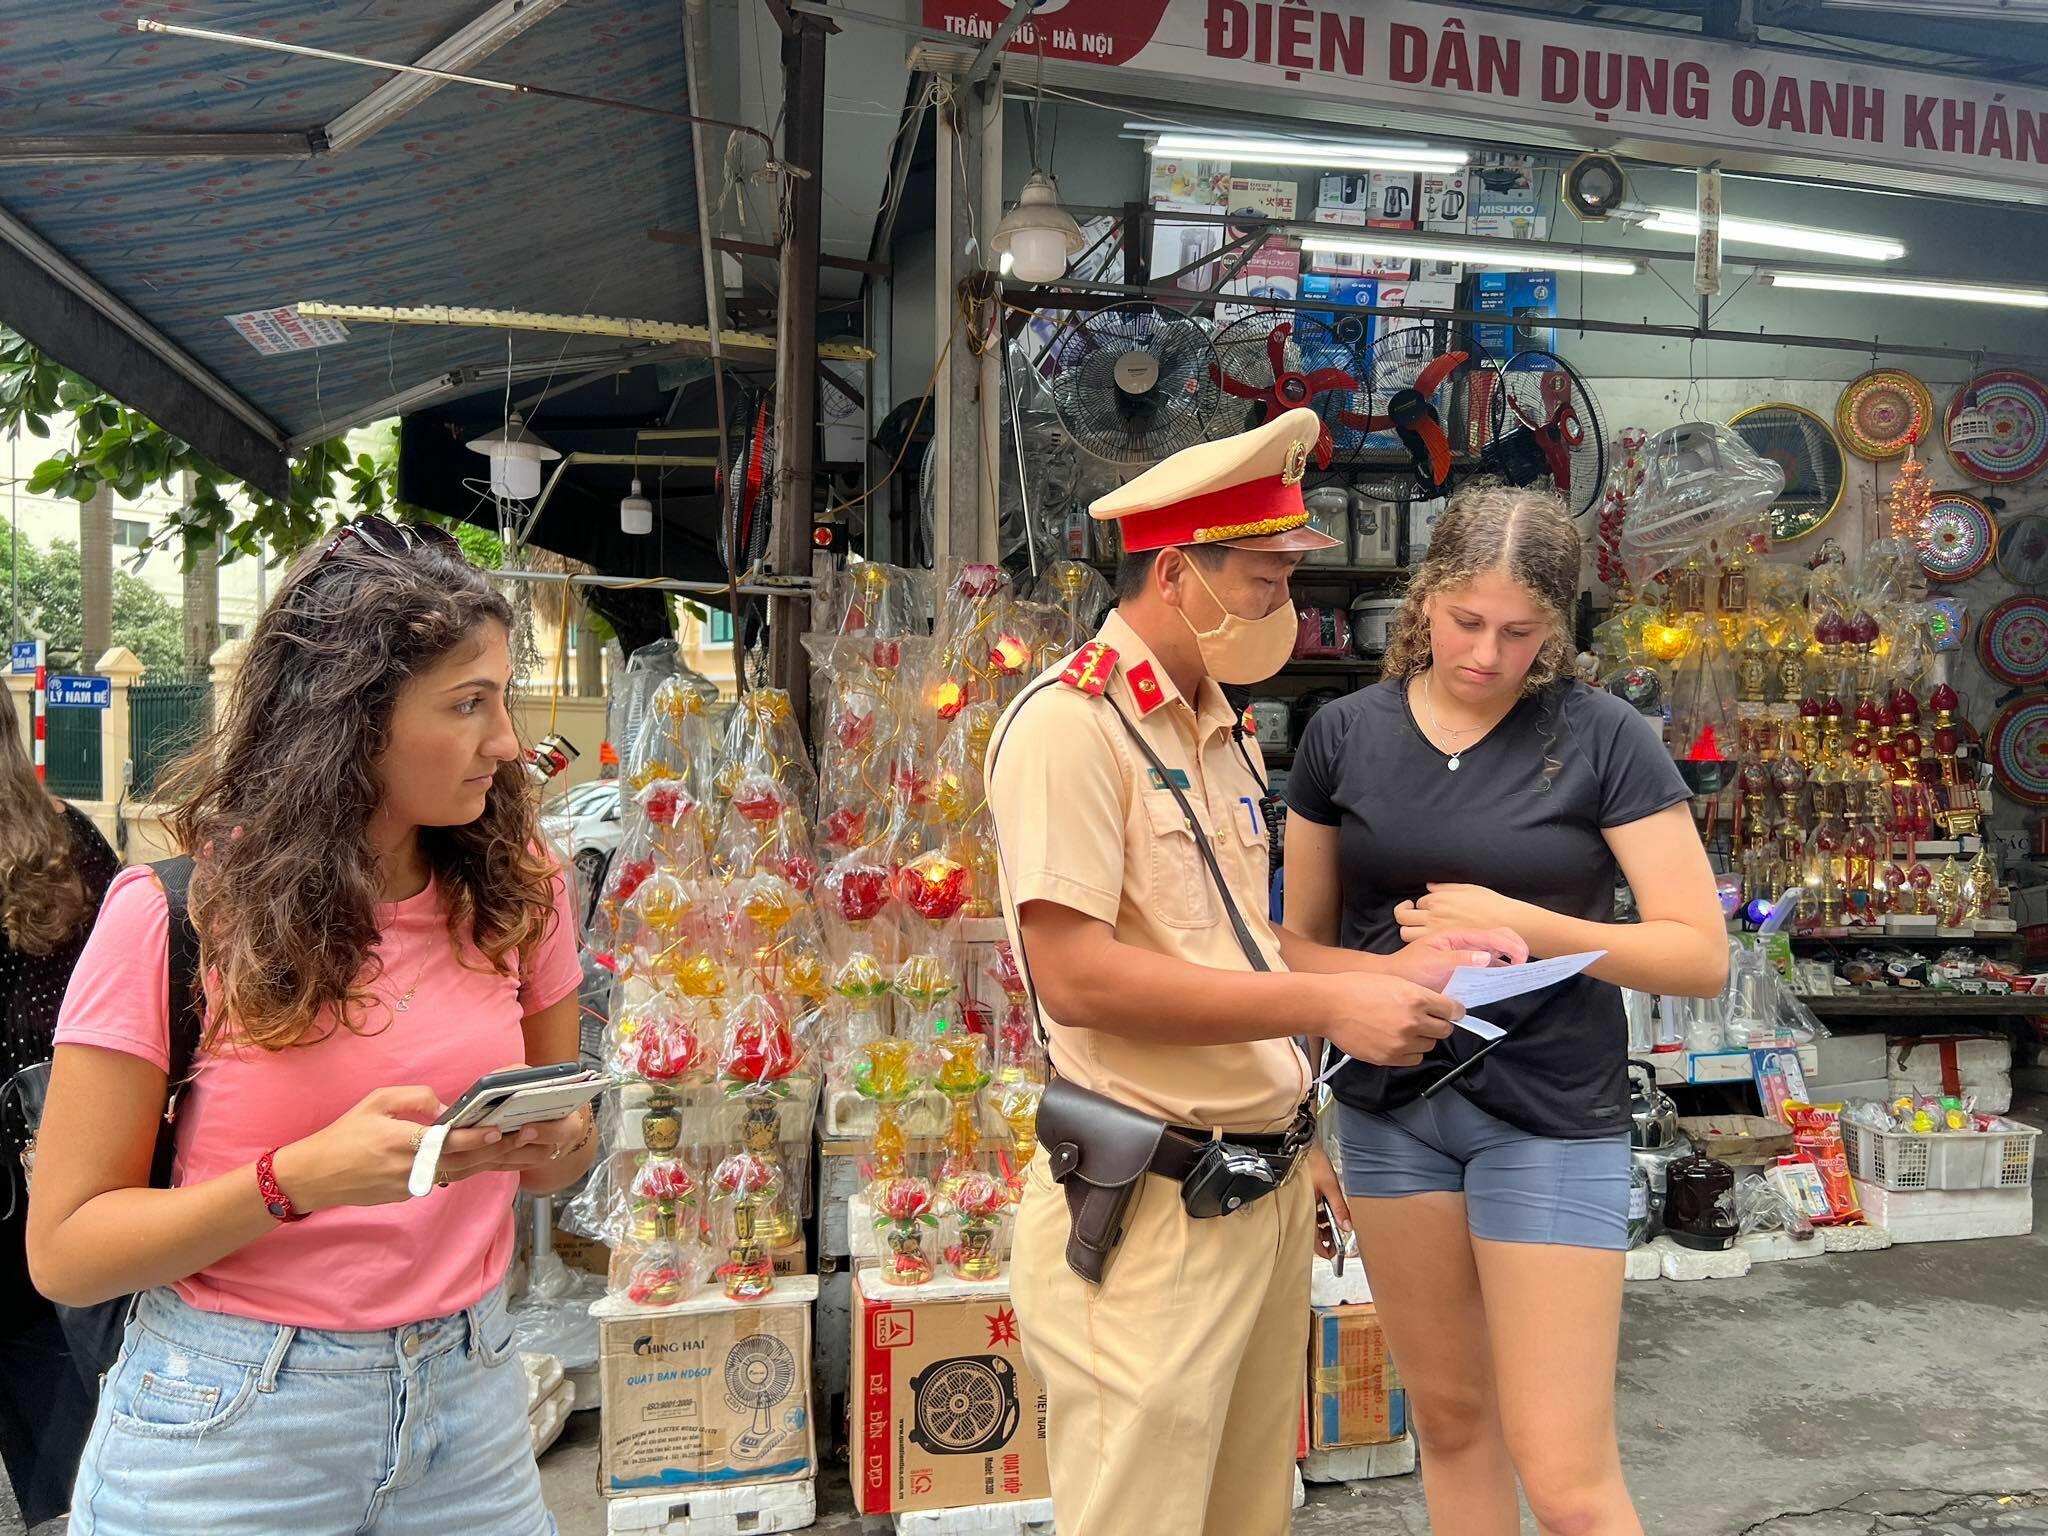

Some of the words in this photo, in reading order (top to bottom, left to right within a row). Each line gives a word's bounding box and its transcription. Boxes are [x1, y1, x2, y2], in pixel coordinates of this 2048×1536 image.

[943, 12, 992, 40] TRẦN
[1052, 28, 1077, 51] HÀ
[1082, 32, 1113, 58] NỘI
[1204, 0, 1365, 82] ĐIỆN
[1389, 17, 1521, 97] DÂN
[1541, 44, 1711, 123] DỤNG
[1730, 68, 1885, 144] OANH
[1903, 91, 2048, 166] KHÁN
[1479, 205, 1534, 214] MISUKO
[72, 680, 93, 689] PHỐ
[49, 690, 63, 703] LÝ
[65, 691, 91, 703] NAM
[93, 689, 108, 703] ĐẾ
[879, 1316, 887, 1344] TICO
[997, 1320, 1008, 1337] NEW
[633, 1335, 679, 1356] CHING
[683, 1339, 705, 1351] HAI
[1036, 1417, 1047, 1440] NAM
[984, 1457, 994, 1475] Model:
[1000, 1453, 1021, 1475] QUẠT
[1000, 1477, 1023, 1495] HỘP
